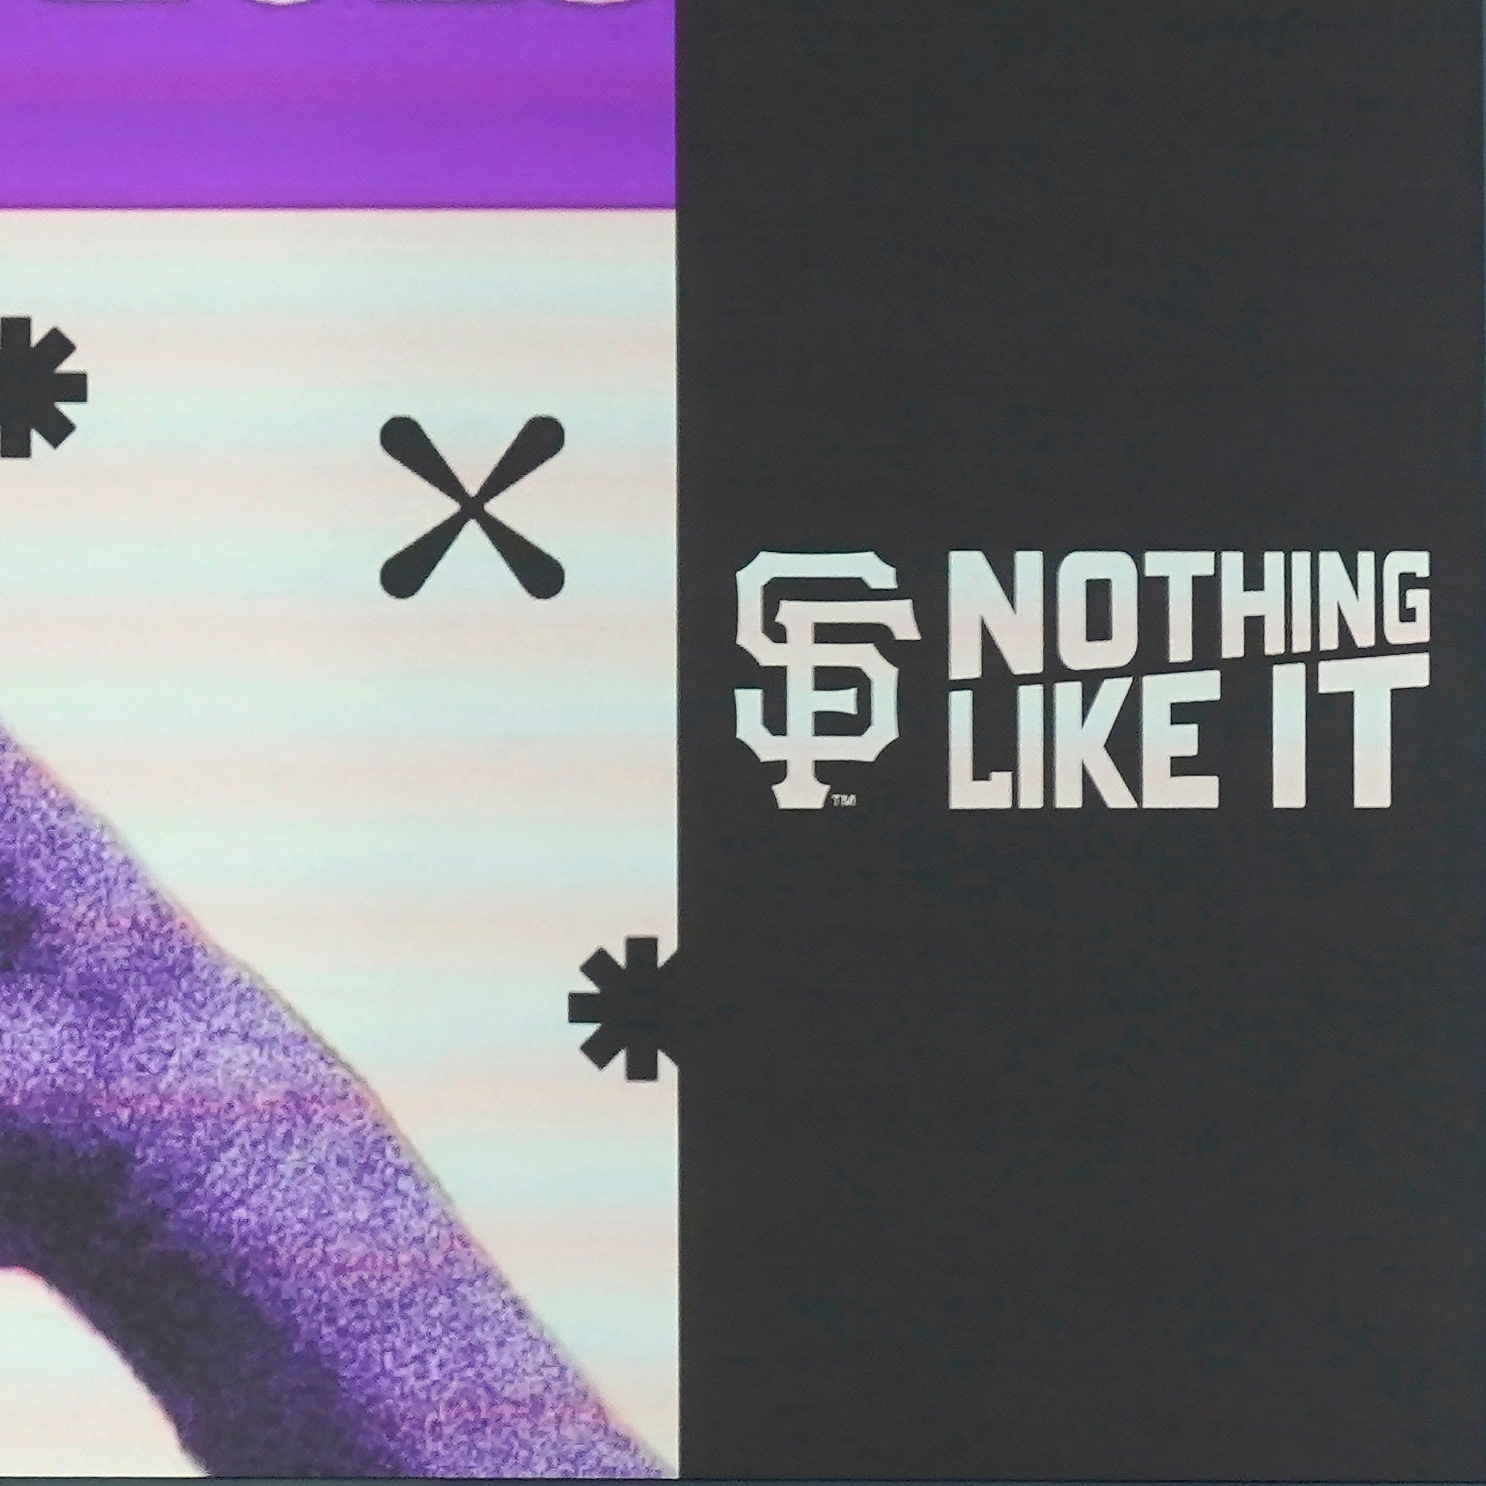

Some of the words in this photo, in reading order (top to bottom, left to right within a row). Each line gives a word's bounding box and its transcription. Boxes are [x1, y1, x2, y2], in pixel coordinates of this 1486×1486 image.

[948, 550, 1431, 680] NOTHING
[948, 669, 1222, 809] LIKE
[1271, 653, 1430, 809] IT
